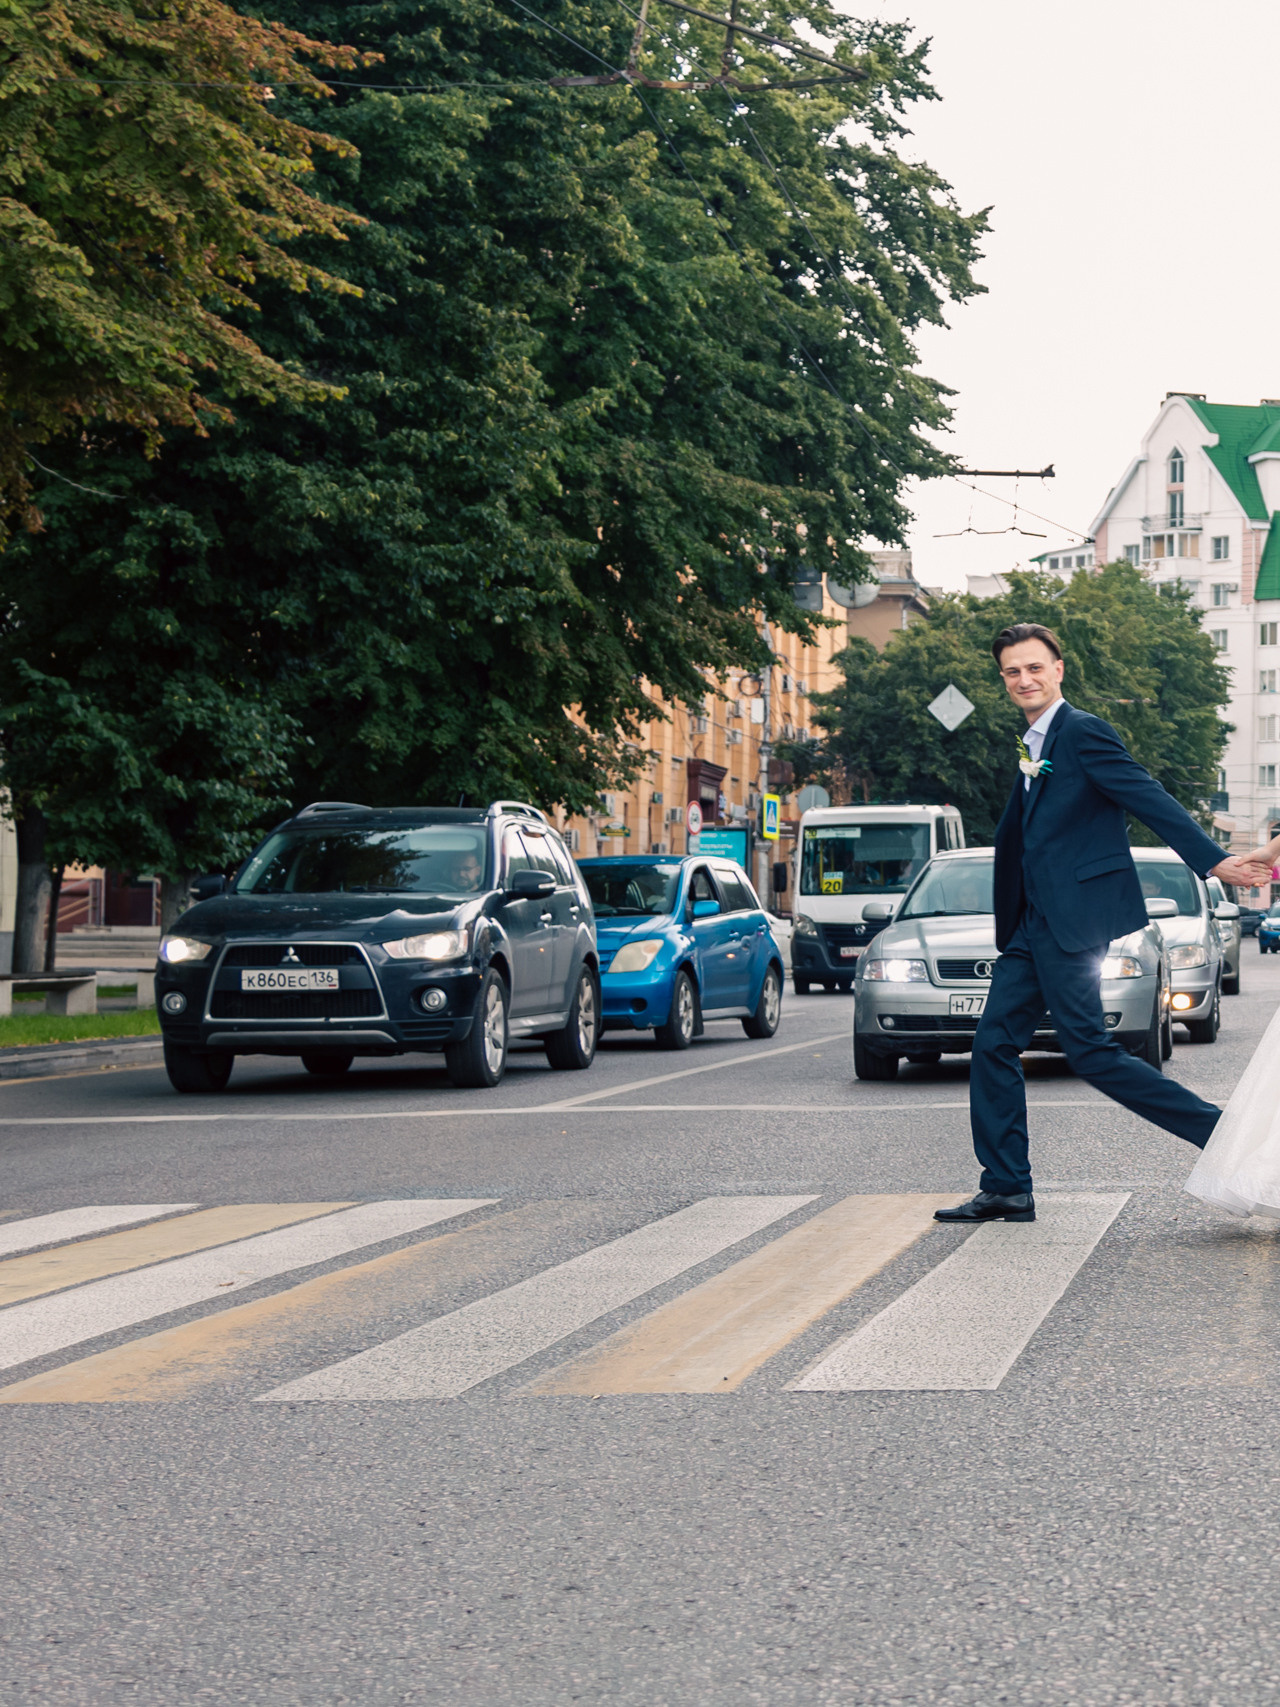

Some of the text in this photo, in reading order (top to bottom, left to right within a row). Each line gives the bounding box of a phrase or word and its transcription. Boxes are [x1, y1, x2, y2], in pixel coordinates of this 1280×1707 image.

[824, 881, 841, 892] 20
[247, 971, 334, 987] К860ЕС 136
[955, 997, 984, 1012] Н77
